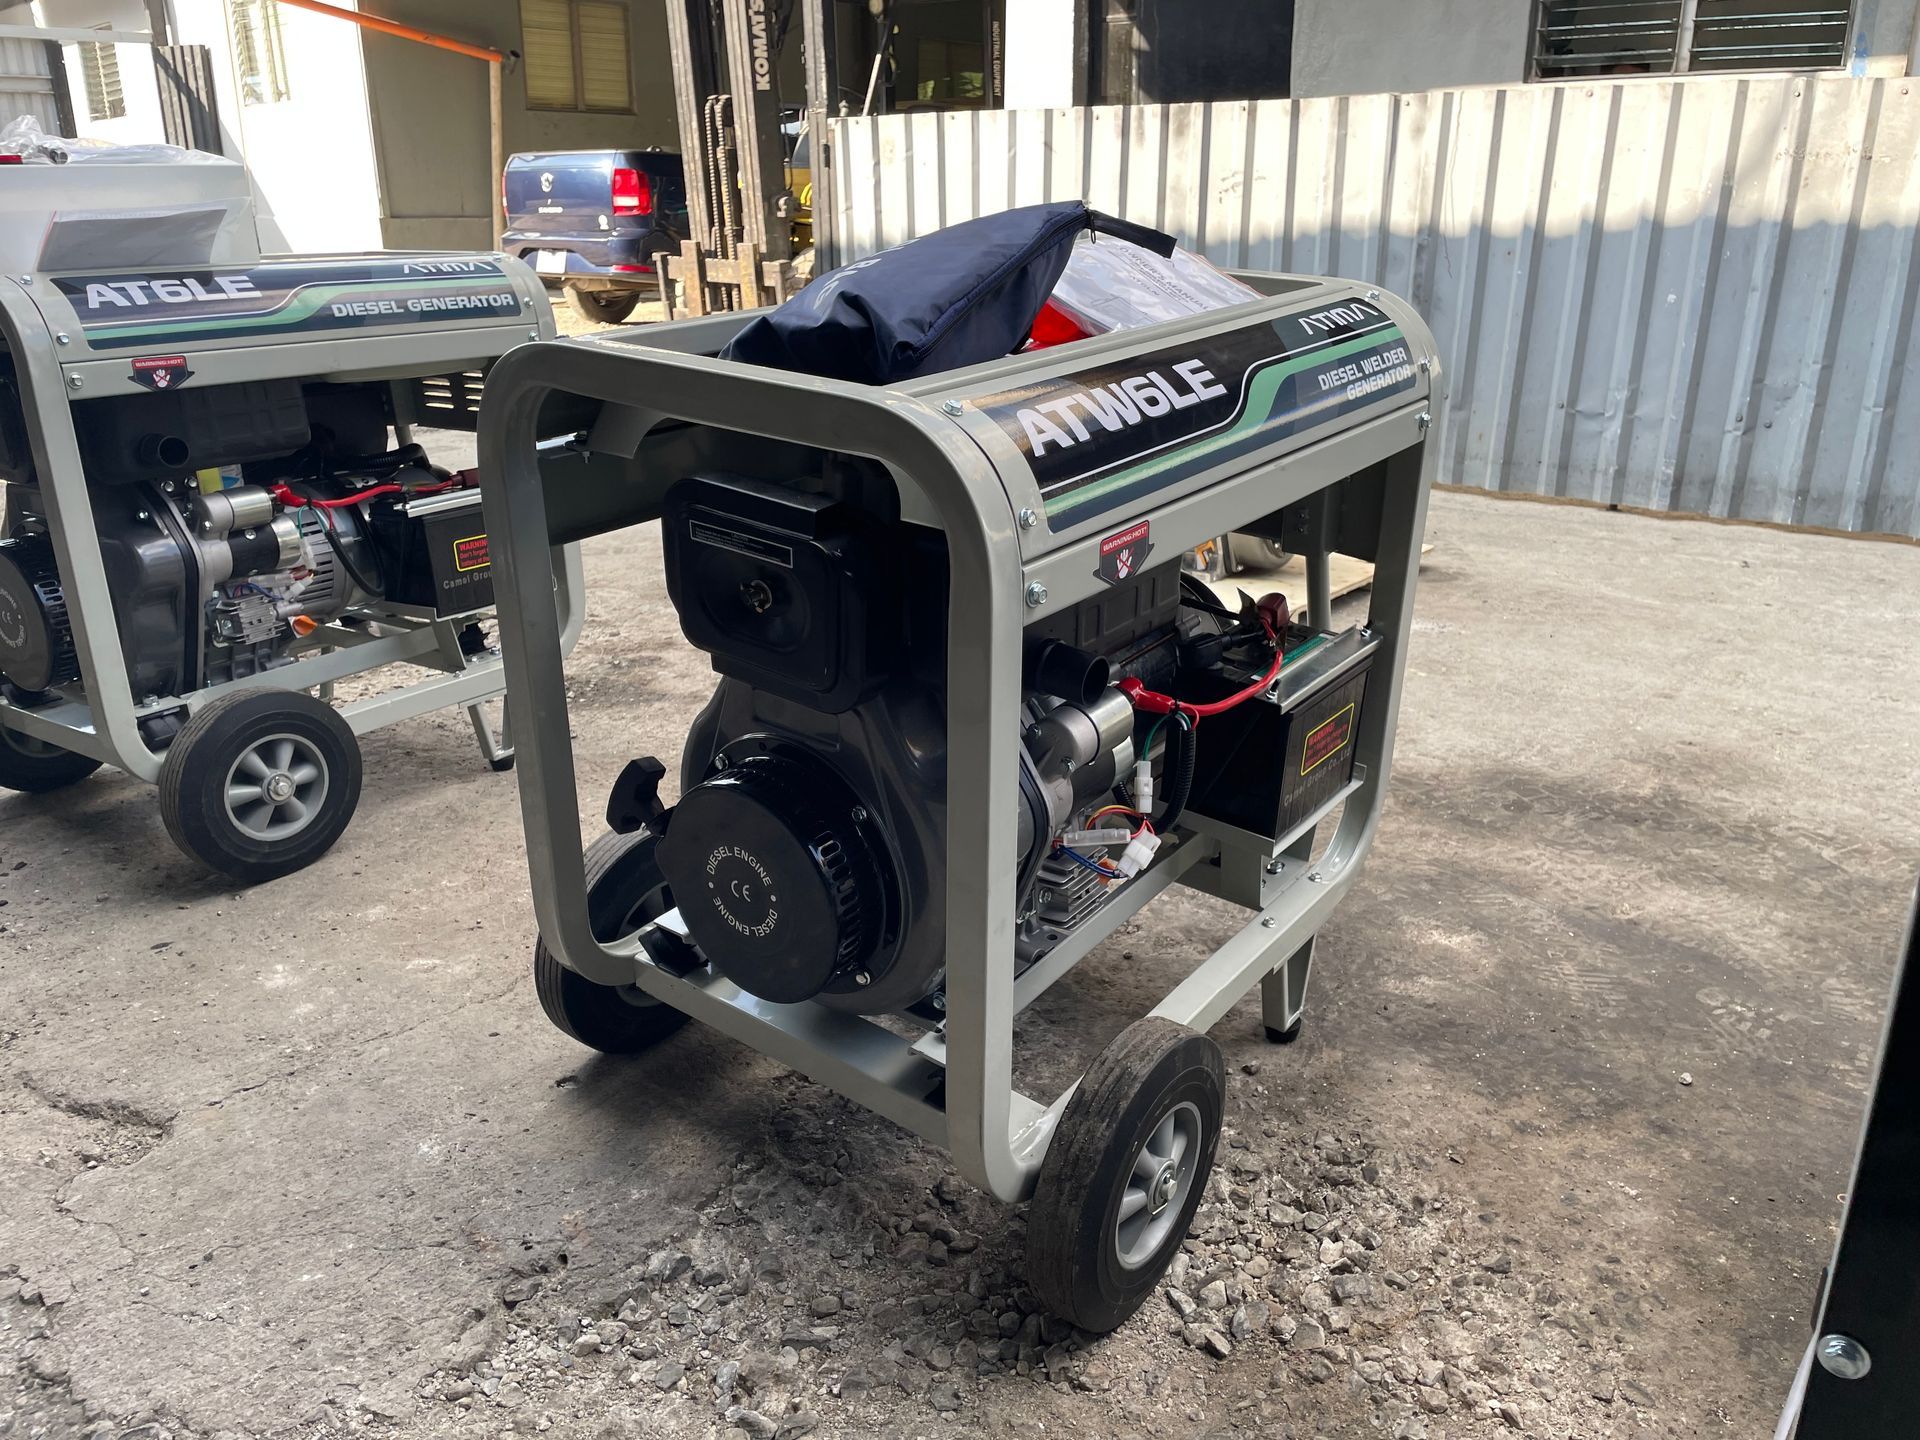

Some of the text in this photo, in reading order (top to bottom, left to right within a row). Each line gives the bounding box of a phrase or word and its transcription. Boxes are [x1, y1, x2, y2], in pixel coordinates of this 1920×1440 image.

[992, 21, 1002, 96] INDUSTRIAL EQUIPMENT
[86, 275, 263, 309] AT6LE
[331, 293, 515, 318] DIESEL GENERATOR
[1318, 347, 1408, 391] DIESEL WELDER
[1346, 363, 1412, 400] GENERATOR
[1016, 358, 1228, 457] ATW6LE
[706, 846, 772, 887] DIESEL ENGINE
[731, 880, 751, 903] CE
[713, 896, 778, 937] DIESEL ENGINE
